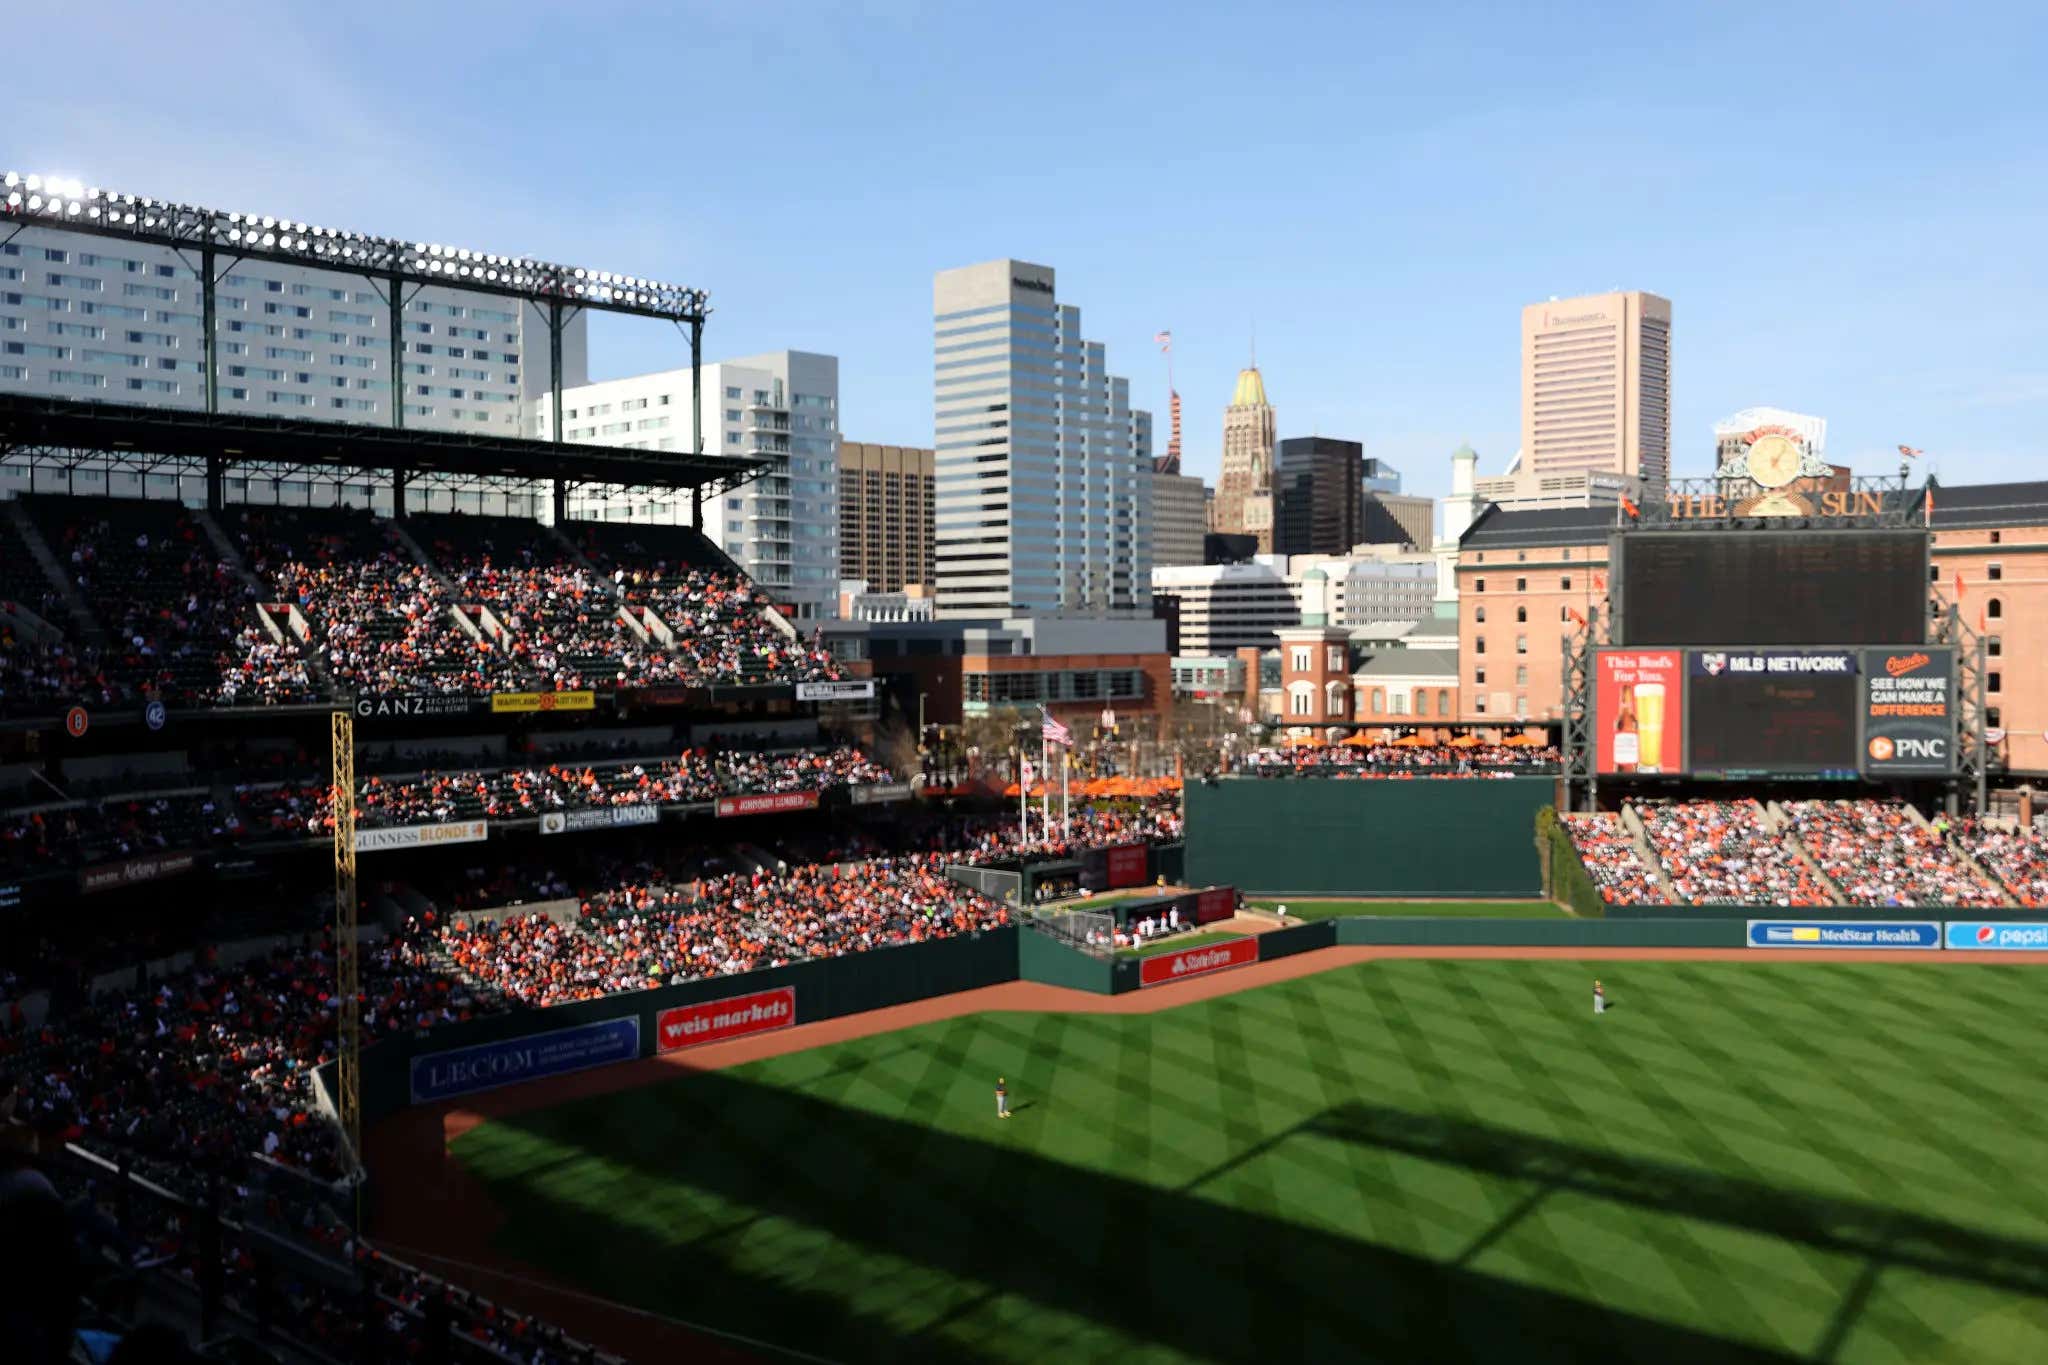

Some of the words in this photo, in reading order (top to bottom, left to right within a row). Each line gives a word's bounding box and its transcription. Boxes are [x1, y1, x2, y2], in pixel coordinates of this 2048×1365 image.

[1666, 492, 1728, 518] THE
[1821, 491, 1883, 516] SUN
[1606, 655, 1637, 668] This
[1638, 655, 1673, 668] Bud's
[1730, 657, 1765, 671] MLB
[1767, 657, 1847, 671] NETWORK
[1614, 669, 1635, 682] For
[1871, 678, 1894, 689] SEE
[1896, 678, 1923, 689] HOW
[1924, 678, 1947, 689] WE
[1871, 691, 1897, 703] CAN
[1899, 691, 1933, 703] MAKE
[1934, 691, 1945, 703] A
[149, 707, 162, 722] 42
[357, 697, 424, 716] GANZ
[1870, 704, 1947, 716] DIFFERENCE
[1895, 739, 1946, 758] PNC
[612, 805, 657, 823] UNION
[419, 825, 468, 842] BLONDE
[1821, 929, 1873, 943] MedStar
[1876, 929, 1920, 943] Health
[1999, 927, 2048, 946] pepsi
[666, 1015, 709, 1038] weis
[713, 1000, 788, 1029] markets
